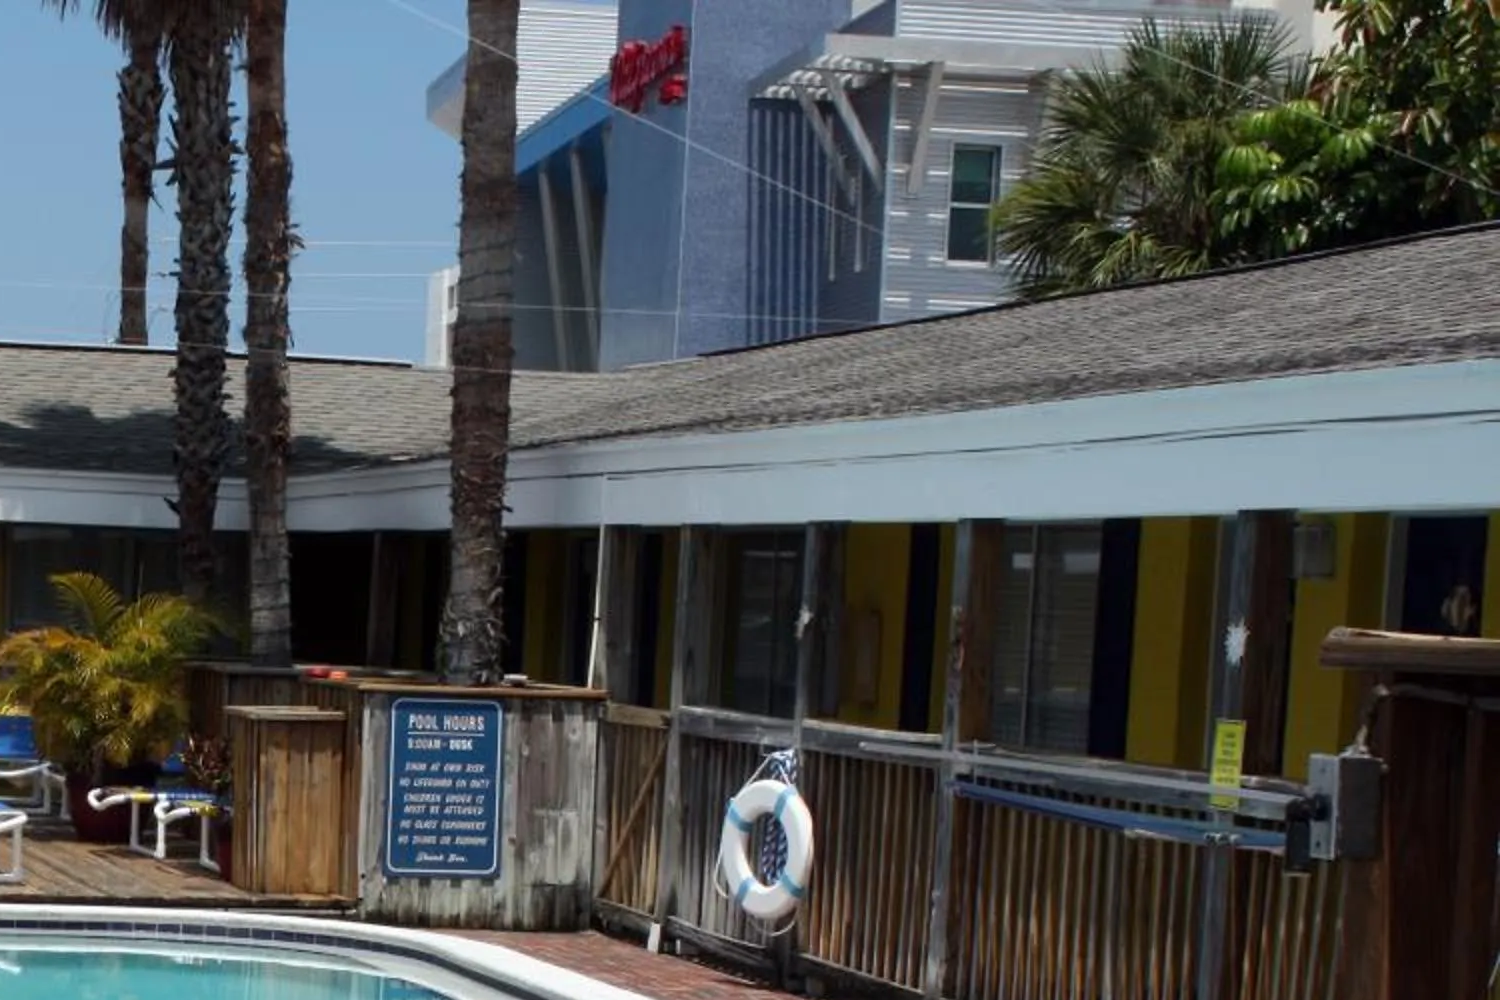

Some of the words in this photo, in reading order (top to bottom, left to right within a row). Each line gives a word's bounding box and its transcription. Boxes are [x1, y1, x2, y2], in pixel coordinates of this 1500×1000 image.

[408, 714, 439, 730] POOL
[443, 715, 485, 731] HOURS
[449, 739, 474, 751] DUSK
